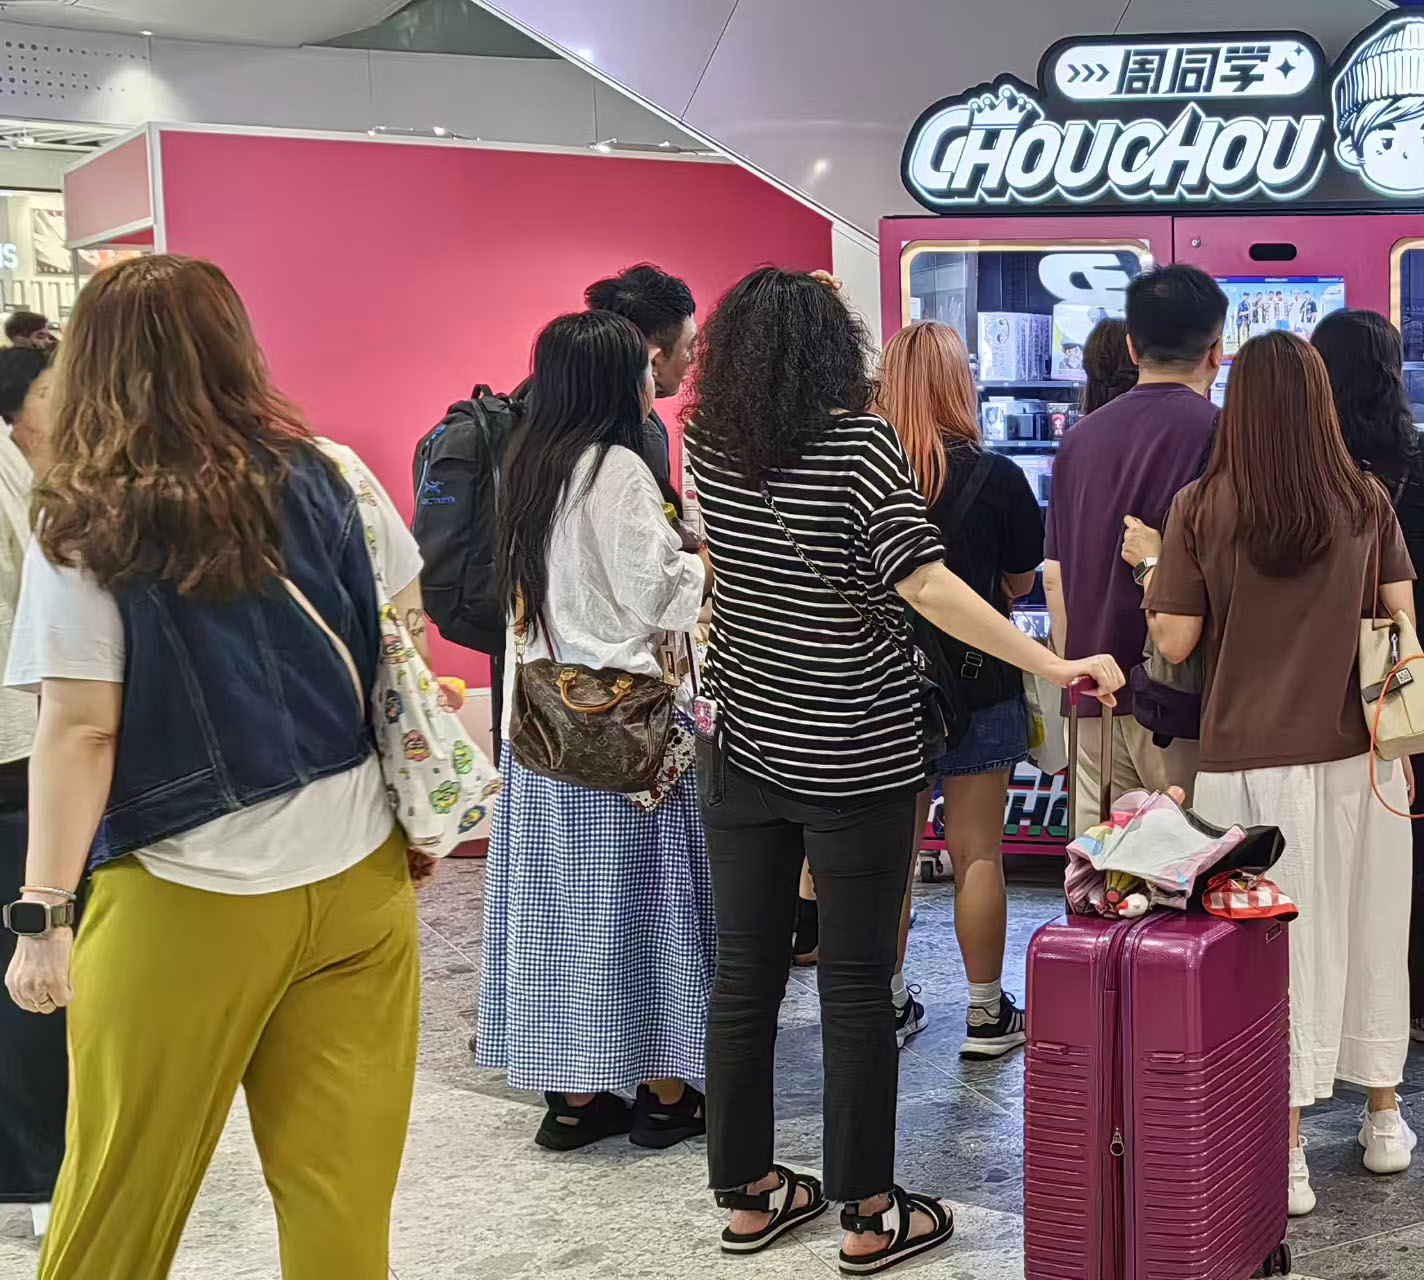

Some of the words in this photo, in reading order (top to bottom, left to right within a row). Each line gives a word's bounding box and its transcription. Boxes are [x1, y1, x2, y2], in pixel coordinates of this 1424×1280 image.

[1109, 46, 1272, 95] 周同学
[909, 102, 1325, 202] CHOUCHOU
